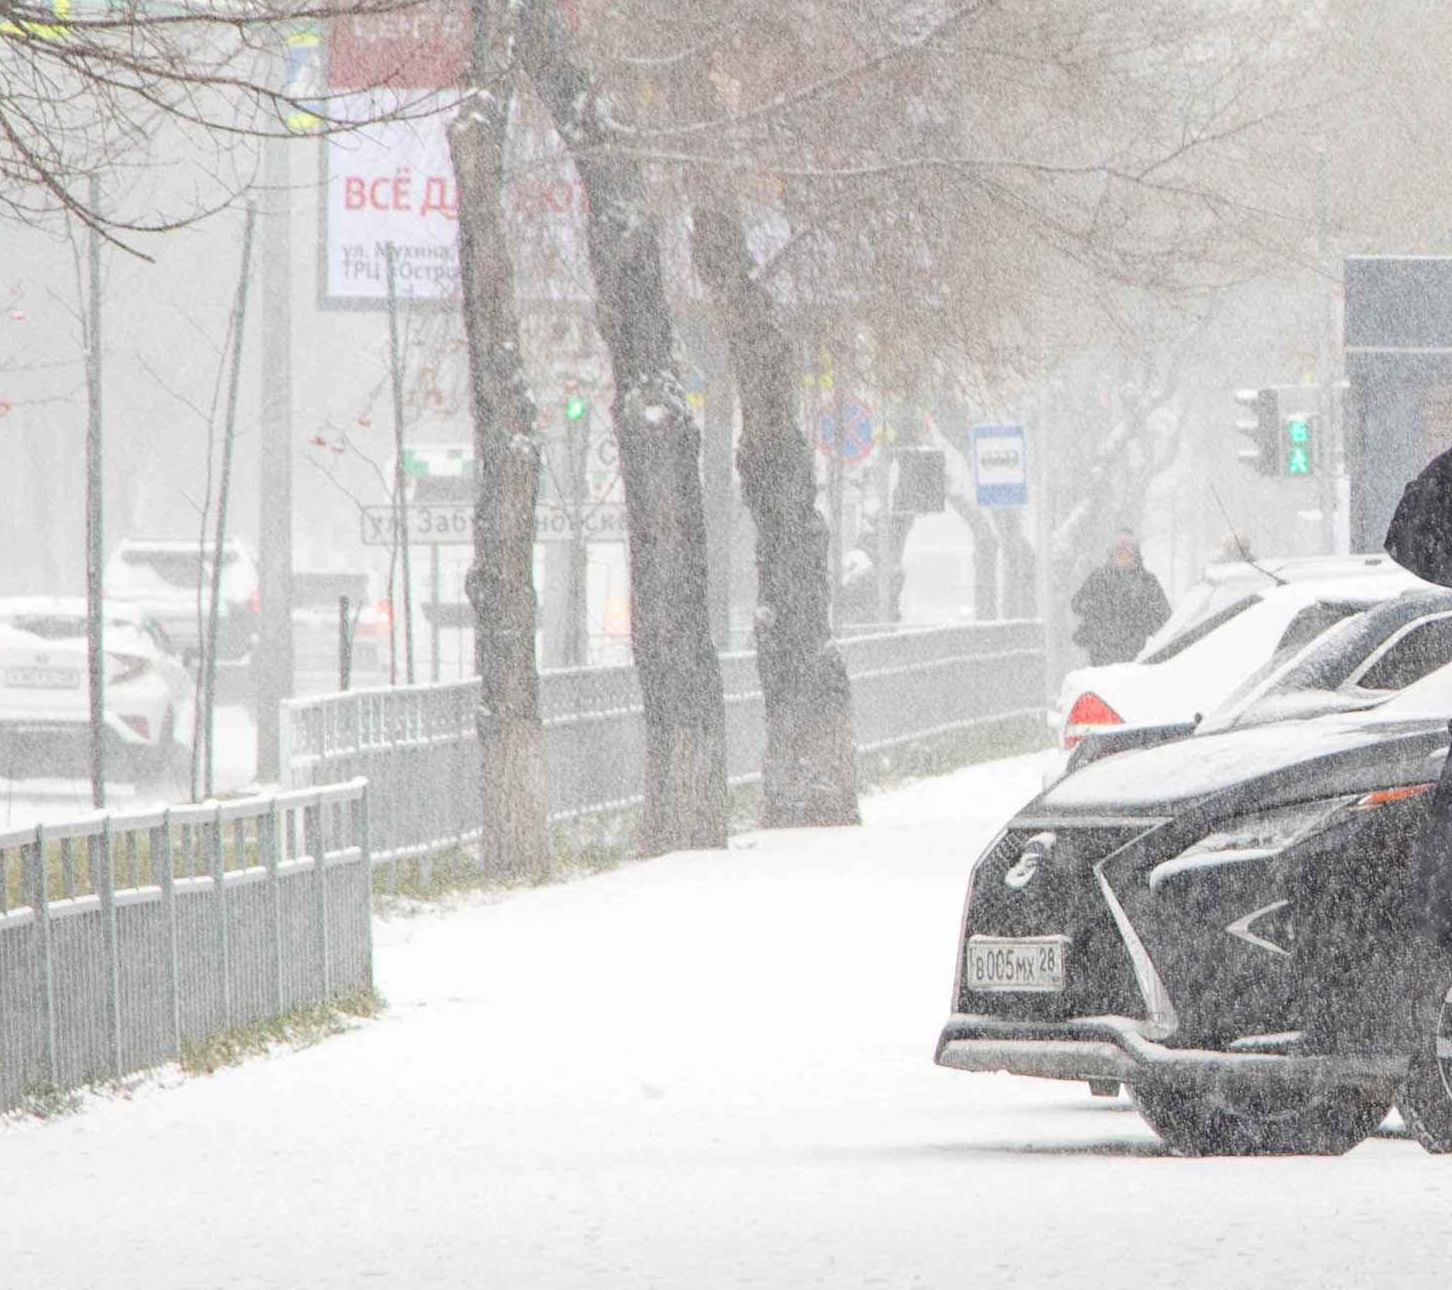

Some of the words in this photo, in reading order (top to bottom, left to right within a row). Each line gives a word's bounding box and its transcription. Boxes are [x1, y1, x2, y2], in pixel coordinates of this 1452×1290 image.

[344, 167, 412, 211] ВСЁ
[341, 261, 380, 282] ТРЦ
[1039, 947, 1056, 972] 28
